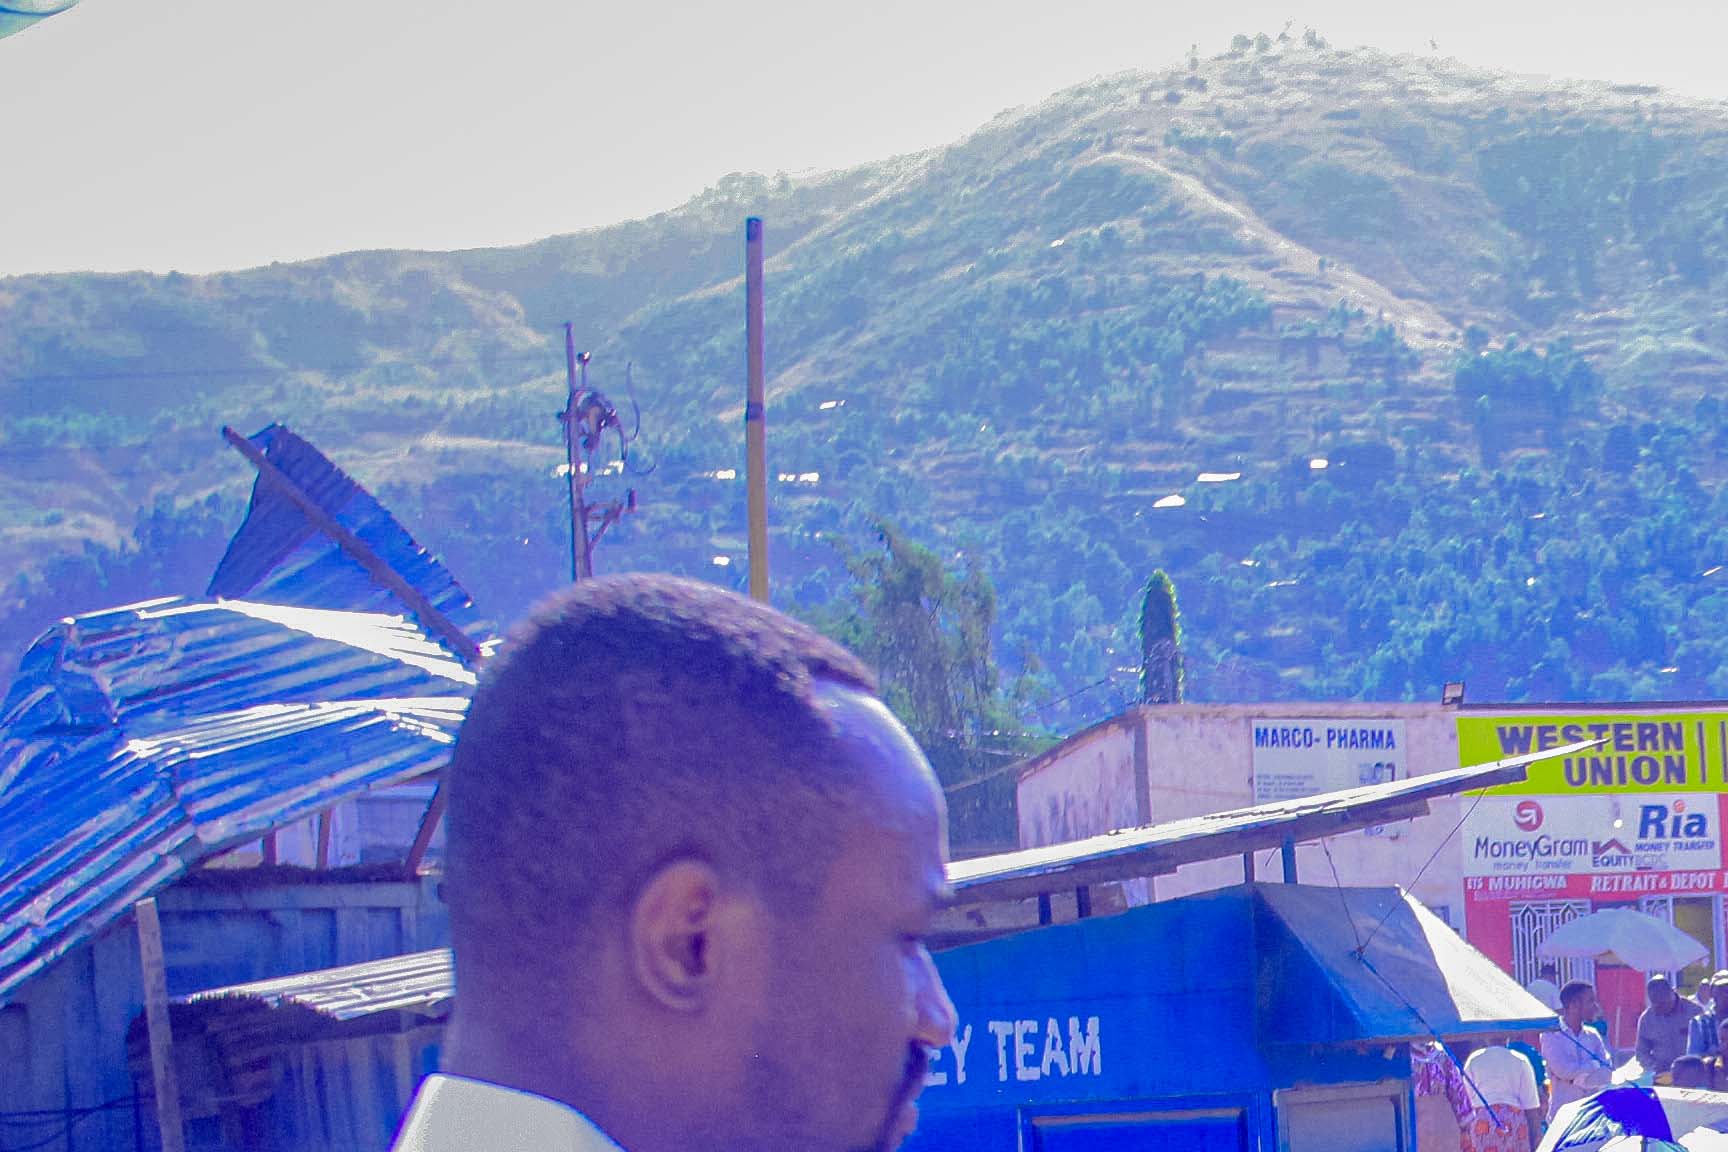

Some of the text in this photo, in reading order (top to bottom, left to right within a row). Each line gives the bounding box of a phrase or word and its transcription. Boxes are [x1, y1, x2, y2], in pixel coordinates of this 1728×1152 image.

[1327, 728, 1396, 749] PHARMA
[1496, 721, 1684, 754] WESTERN
[1564, 755, 1687, 787] UNION
[1638, 800, 1708, 839] Ria
[1474, 834, 1588, 861] MoneyGram
[1635, 842, 1670, 852] MONEY
[1592, 855, 1634, 868] EQUITY
[1591, 873, 1657, 893] RETRAIT
[1671, 872, 1717, 890] DEPOT
[988, 1016, 1102, 1082] TEAM
